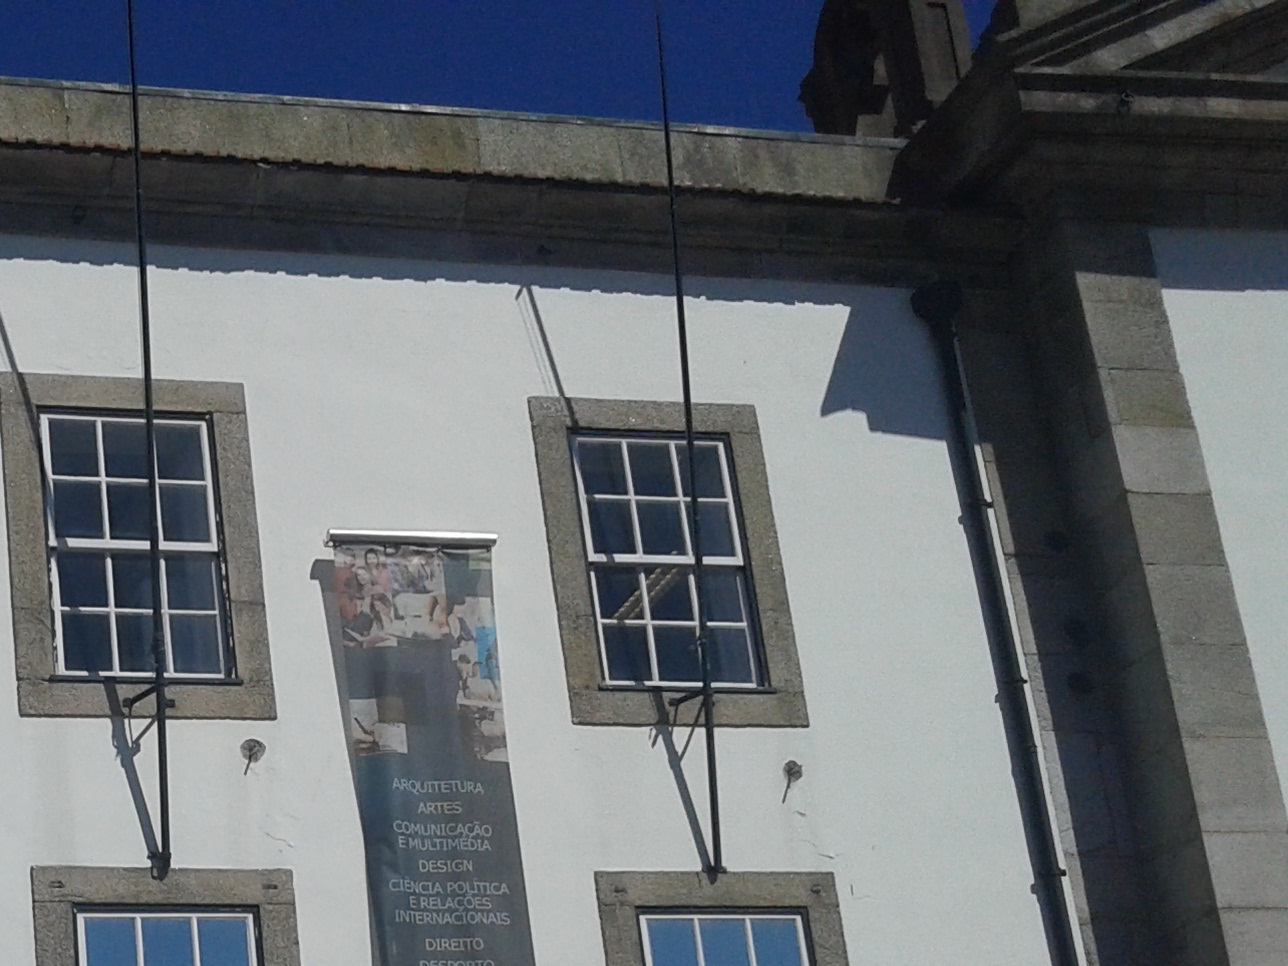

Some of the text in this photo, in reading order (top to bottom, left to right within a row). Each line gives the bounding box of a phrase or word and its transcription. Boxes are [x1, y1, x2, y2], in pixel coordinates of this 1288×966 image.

[392, 778, 484, 794] ARQUITETURA
[417, 801, 462, 814] ARTES
[393, 820, 492, 838] COMUNICAÇÃO
[398, 836, 492, 851] E MULTIMÉDIA
[419, 859, 473, 872] DESIGN
[389, 876, 509, 894] CIÊNCIA POLÍTICA
[409, 894, 492, 911] E RELAÇÕES
[395, 910, 511, 925] INTERNACIONAIS
[425, 938, 484, 951] DIREITO
